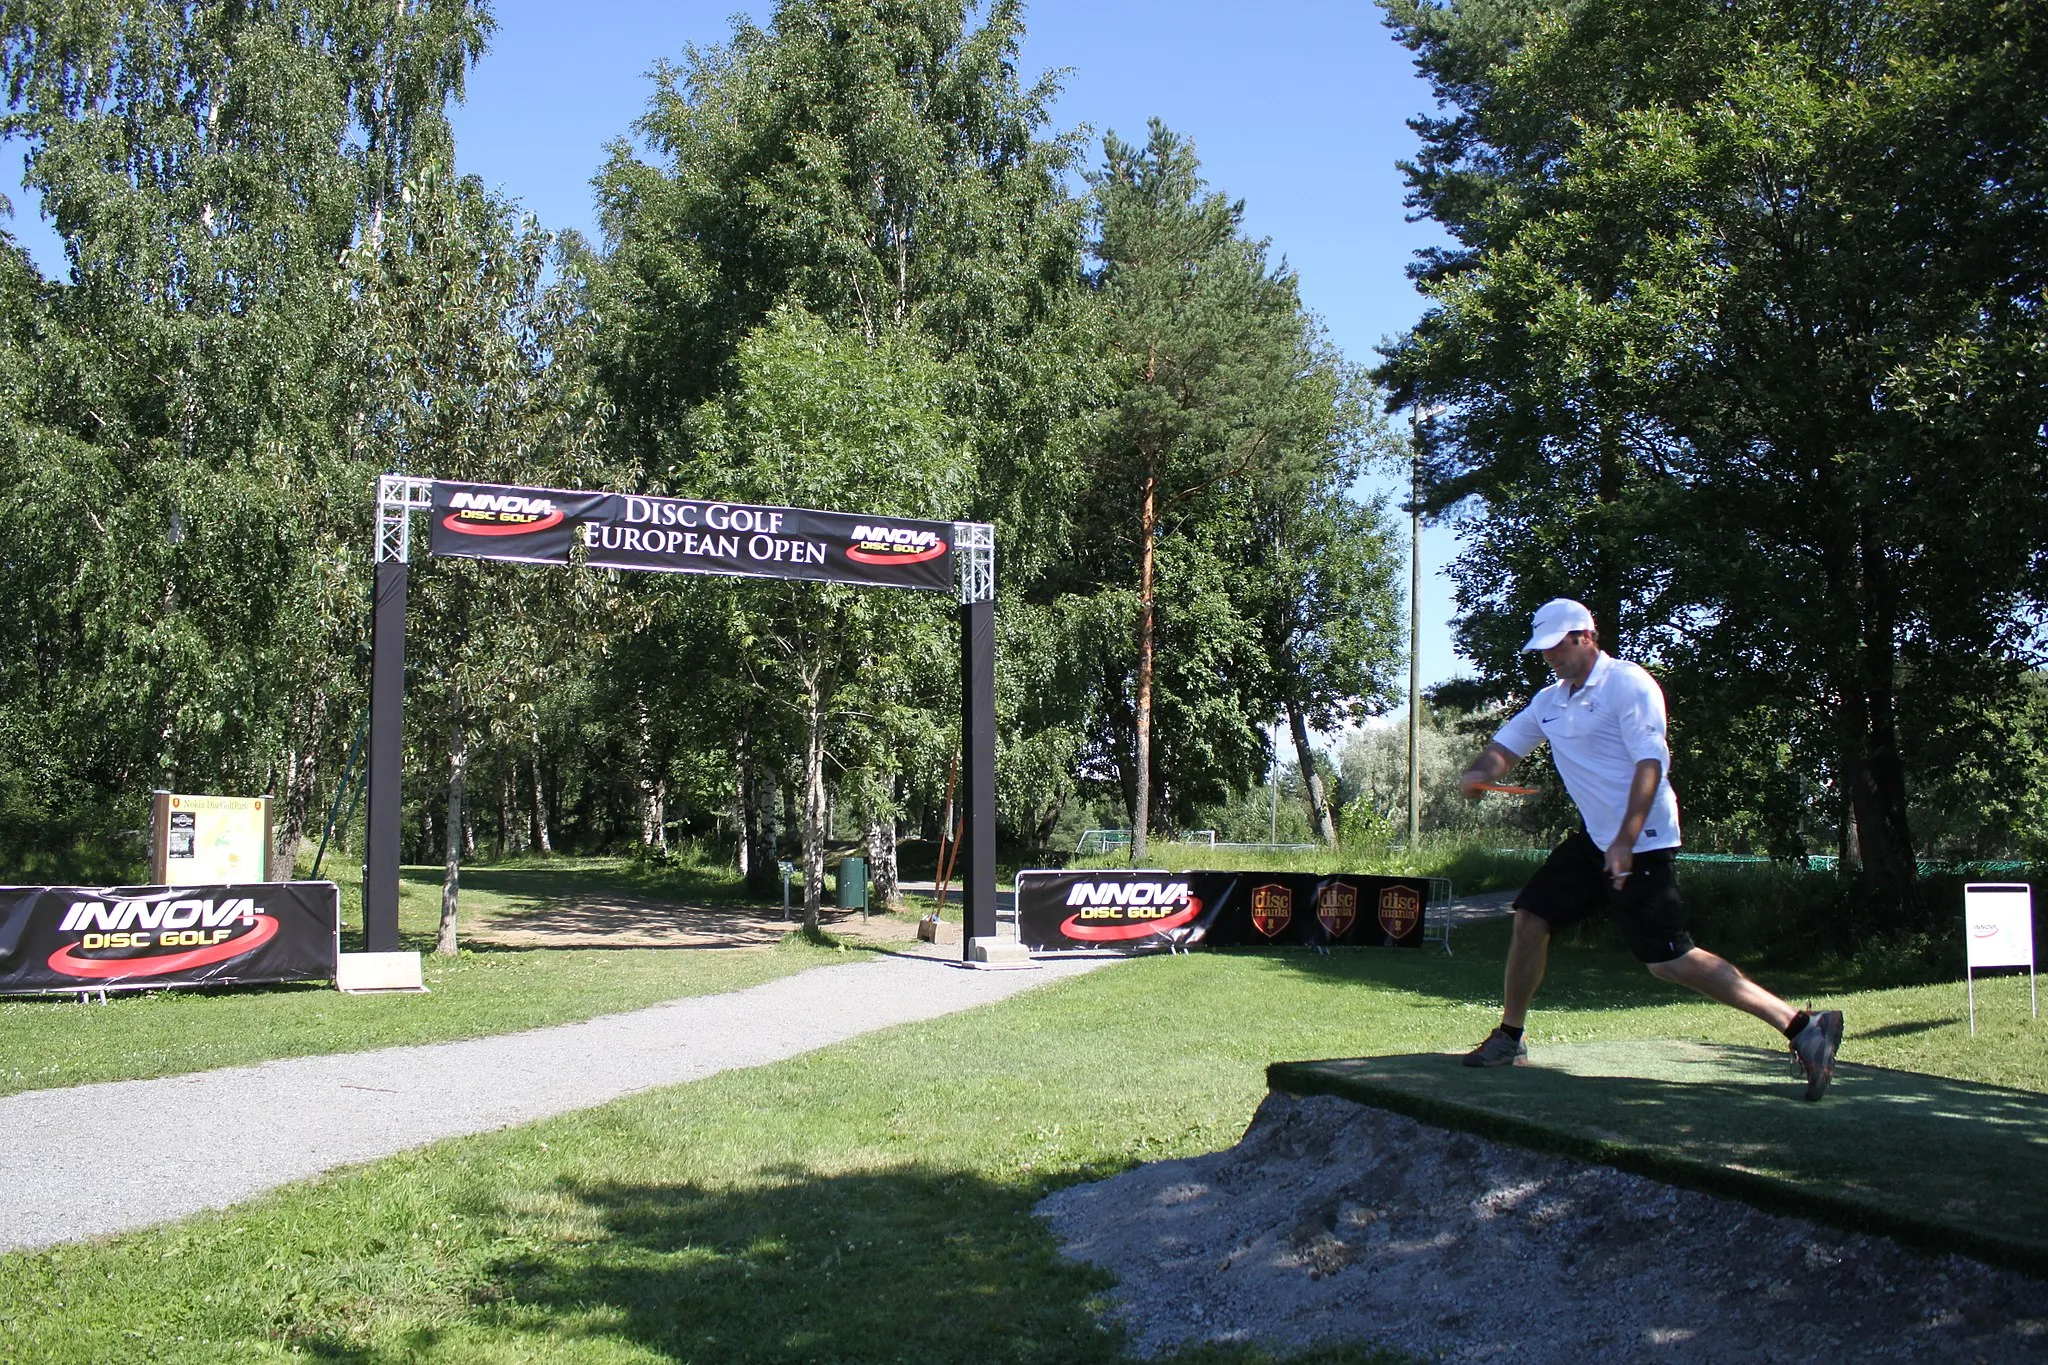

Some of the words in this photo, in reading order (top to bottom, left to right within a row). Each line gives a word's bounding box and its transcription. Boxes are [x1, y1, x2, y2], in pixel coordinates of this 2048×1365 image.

[449, 492, 552, 515] INNOVA
[461, 509, 496, 521] DISC
[499, 513, 539, 523] GOLF
[851, 525, 936, 547] INNOVA
[860, 540, 890, 551] DISC
[893, 543, 925, 554] GOLF
[1066, 883, 1188, 905] INNOVA
[1255, 891, 1289, 908] disc
[1320, 889, 1353, 908] disc
[1382, 892, 1416, 910] disc
[59, 898, 254, 931] INNOVA
[1080, 906, 1123, 919] DISC
[1127, 906, 1173, 918] GOLF
[1254, 907, 1288, 917] mania
[1319, 907, 1353, 917] mania
[1381, 908, 1416, 919] mania
[83, 931, 150, 949] DISC
[159, 929, 232, 946] GOLF
